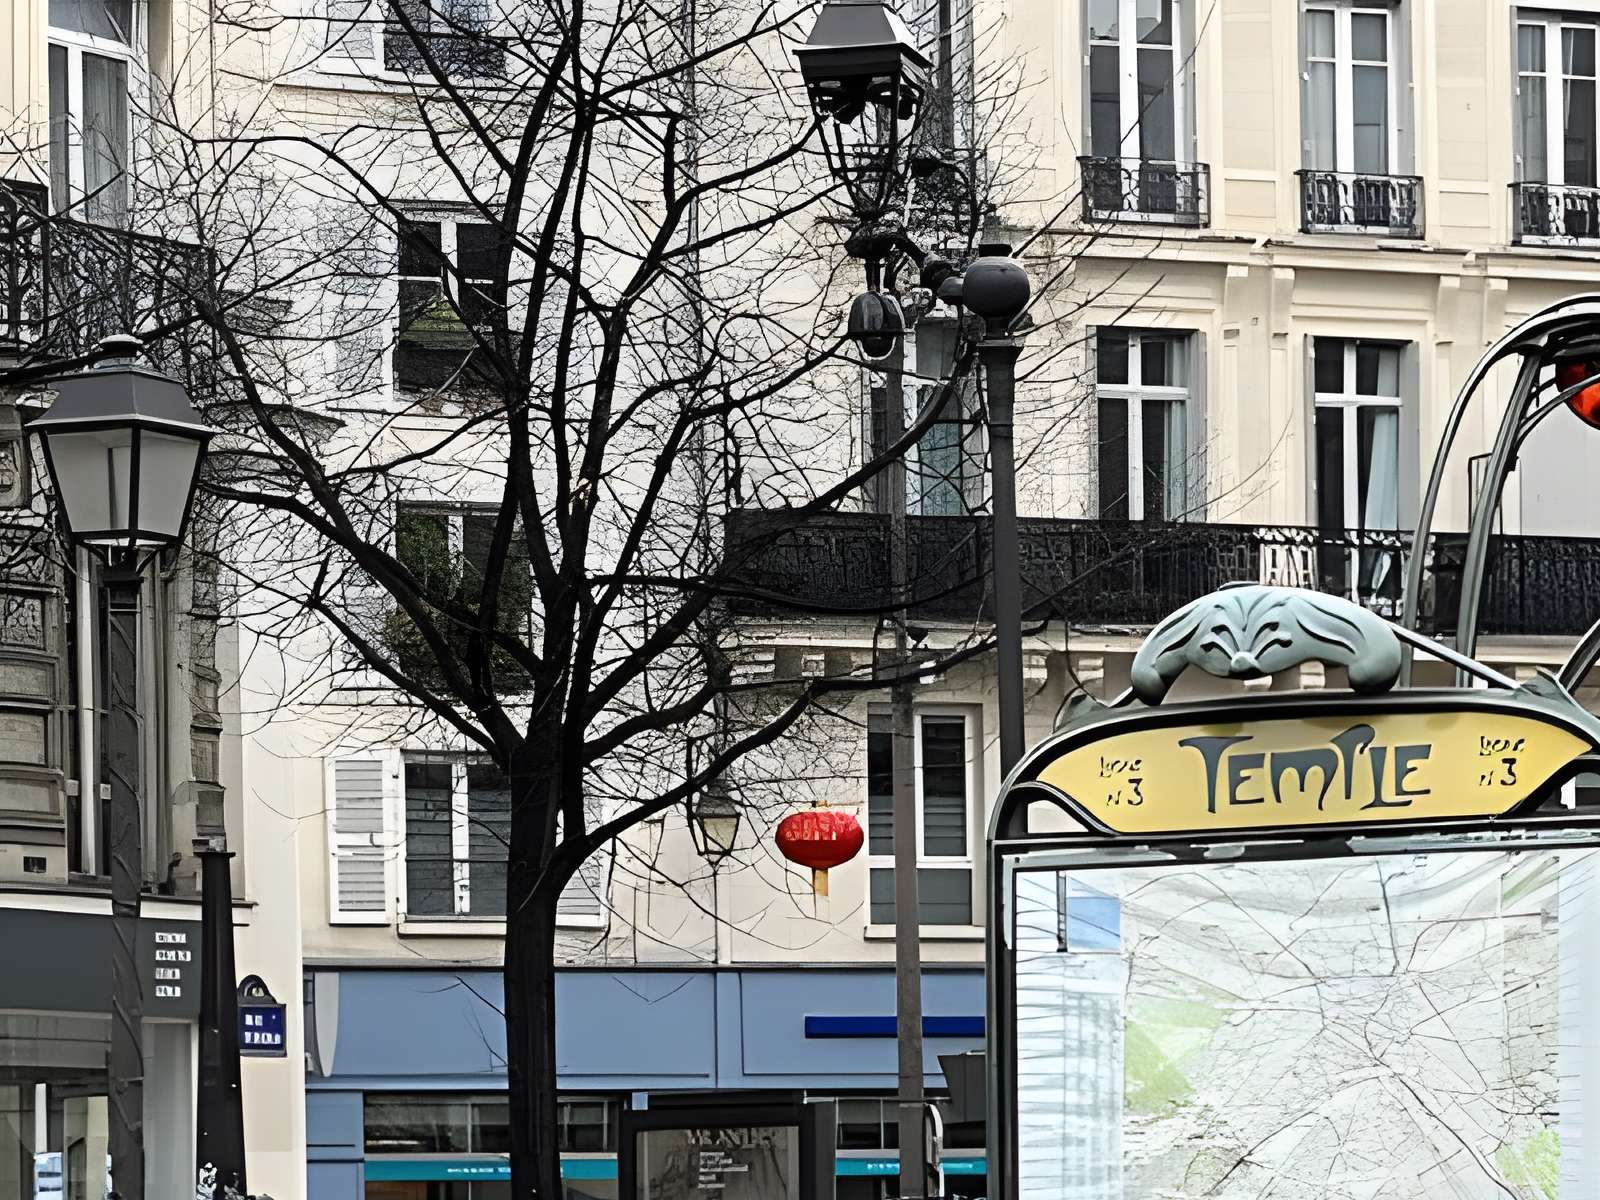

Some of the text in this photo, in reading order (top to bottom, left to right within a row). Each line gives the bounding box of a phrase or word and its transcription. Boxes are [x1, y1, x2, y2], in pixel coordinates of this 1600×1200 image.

[1178, 723, 1432, 814] TEMPLE
[1500, 757, 1517, 786] 3
[1127, 777, 1144, 806] 3
